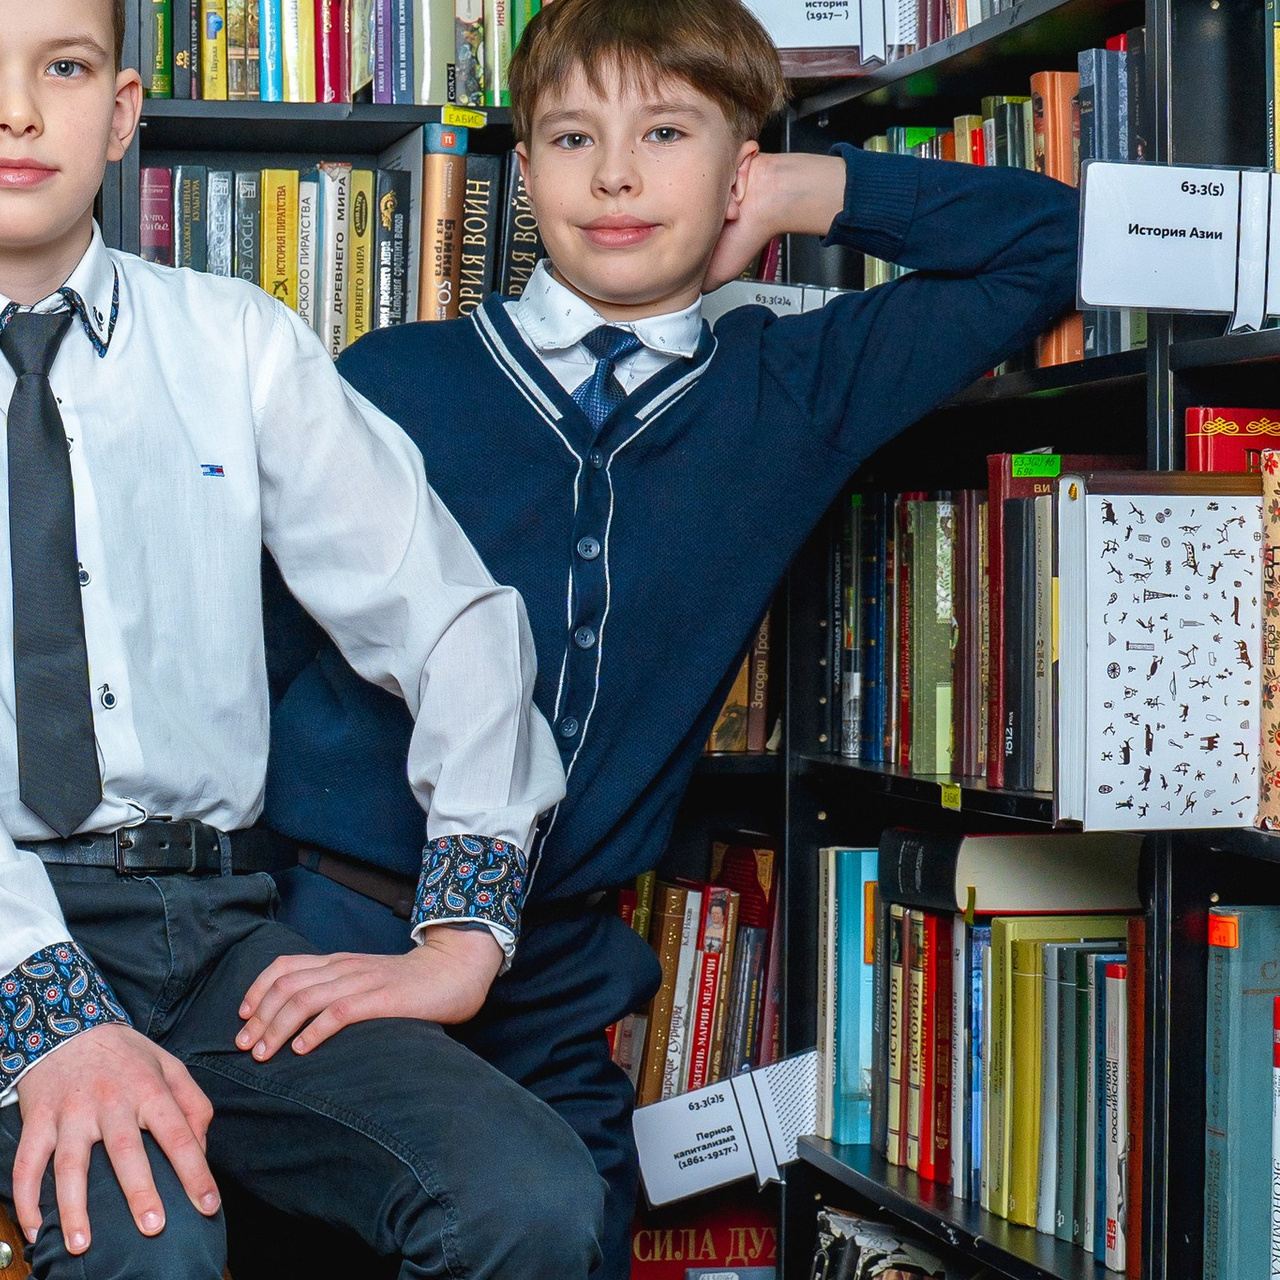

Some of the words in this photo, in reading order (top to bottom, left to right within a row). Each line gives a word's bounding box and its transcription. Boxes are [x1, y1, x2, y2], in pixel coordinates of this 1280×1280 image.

[805, 0, 848, 9] история
[449, 114, 479, 125] ЕАБИС
[1181, 180, 1225, 197] 63.3(5)
[276, 185, 286, 235] ПИРАТСТВА
[437, 219, 443, 234] из
[1128, 223, 1186, 240] История
[1190, 227, 1223, 242] Азии
[276, 237, 286, 276] ИСТОРИЯ
[355, 245, 365, 277] МИРА
[434, 244, 442, 277] грота
[443, 219, 456, 279] Байки
[354, 279, 365, 332] ДРЕВНЕГО
[433, 280, 452, 305] 50
[755, 293, 792, 307] 63.3(2)4
[703, 957, 717, 1001] МЕДИЧИ
[700, 1002, 712, 1045] МАРИИ
[889, 977, 898, 1068] ИСТОРИЯ
[911, 981, 920, 1073] ИСТОРИЯ
[692, 1044, 707, 1089] ЖИЗНЬ
[688, 1093, 725, 1111] 63.3(2)5
[1111, 1061, 1119, 1145] РОССИЙСКАЯ
[673, 1135, 739, 1161] капитализма
[696, 1125, 734, 1143] Период
[678, 1143, 740, 1171] (1861-1917г.)
[633, 1228, 717, 1263] СИЛА
